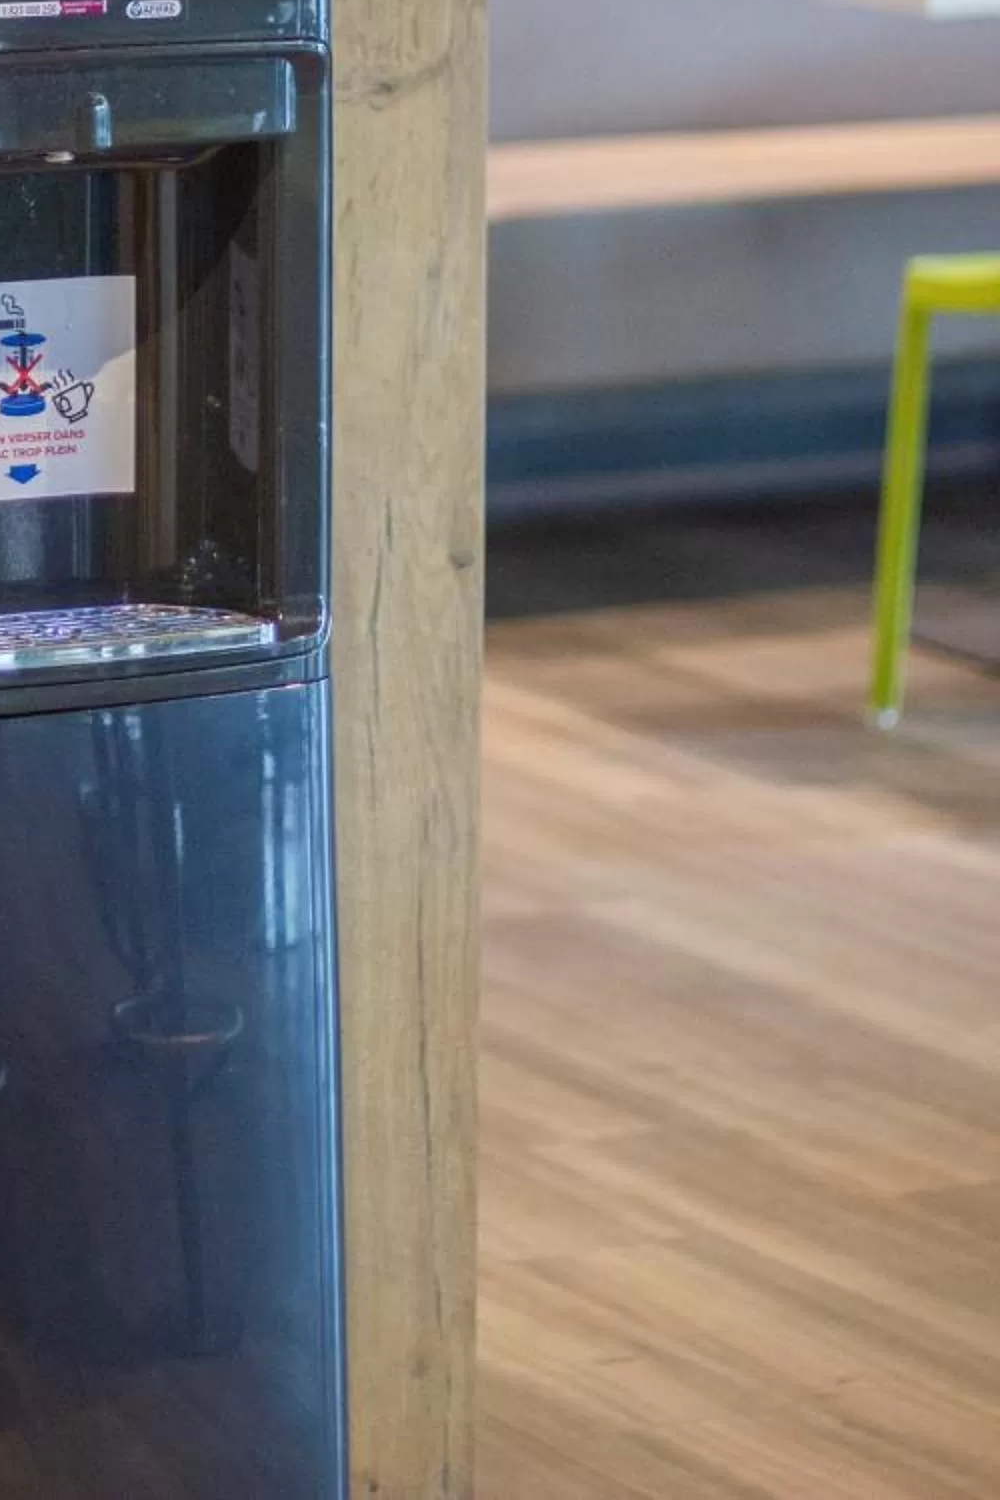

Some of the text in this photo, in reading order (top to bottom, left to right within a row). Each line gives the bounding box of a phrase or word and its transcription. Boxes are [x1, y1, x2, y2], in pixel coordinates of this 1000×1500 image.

[8, 431, 51, 443] VERSER
[53, 428, 86, 440] DANS
[13, 446, 41, 457] TROP
[45, 444, 77, 455] PLEIN
